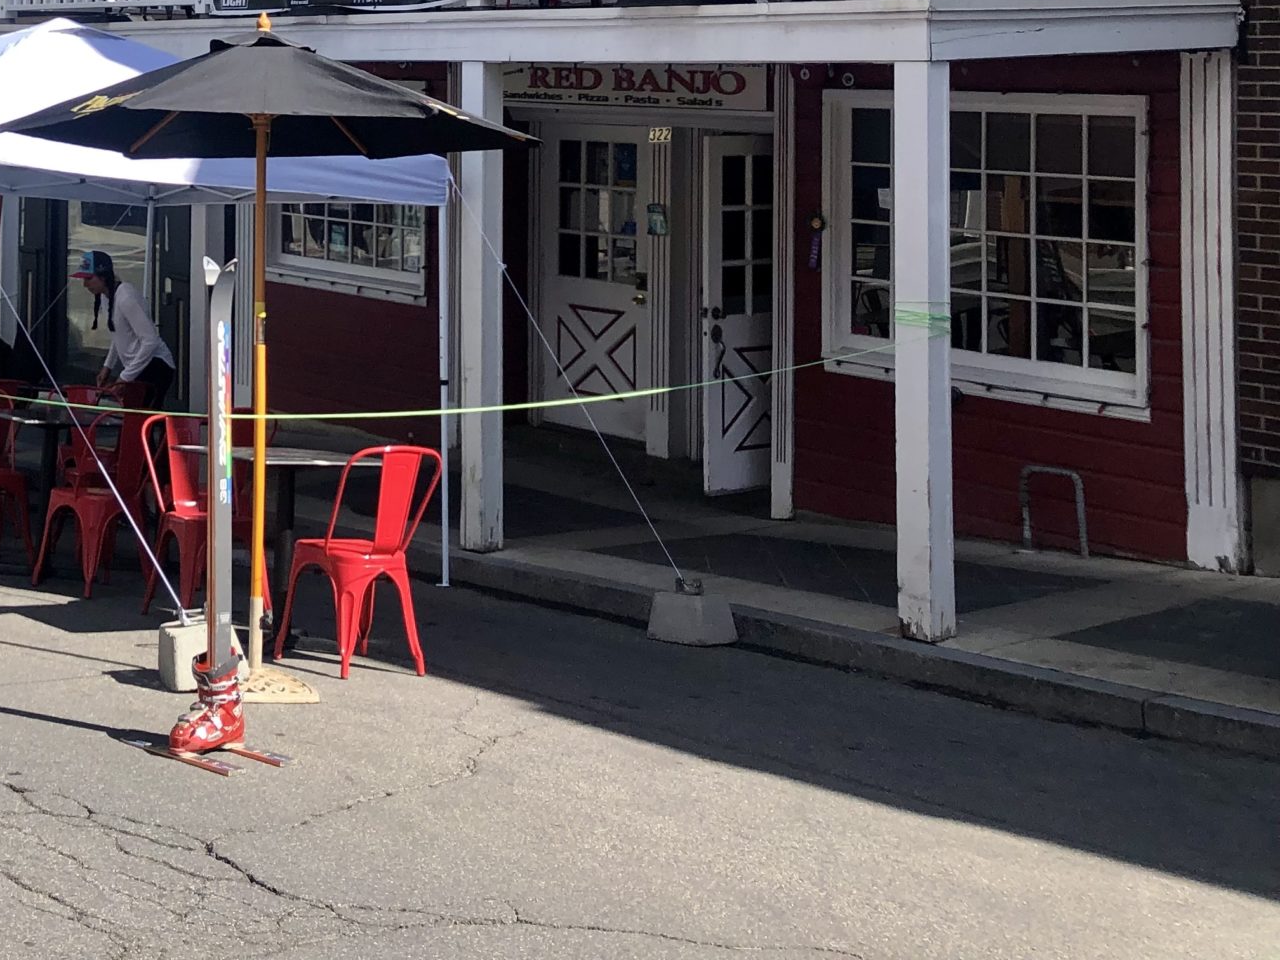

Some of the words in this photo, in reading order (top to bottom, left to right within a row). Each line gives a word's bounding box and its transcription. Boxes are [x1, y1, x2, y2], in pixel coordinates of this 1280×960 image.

[528, 66, 603, 90] RED
[612, 67, 747, 96] BANJO
[503, 90, 563, 100] Sandwiches
[578, 93, 609, 102] Pizza
[624, 95, 661, 105] Pasta
[649, 128, 671, 142] 322
